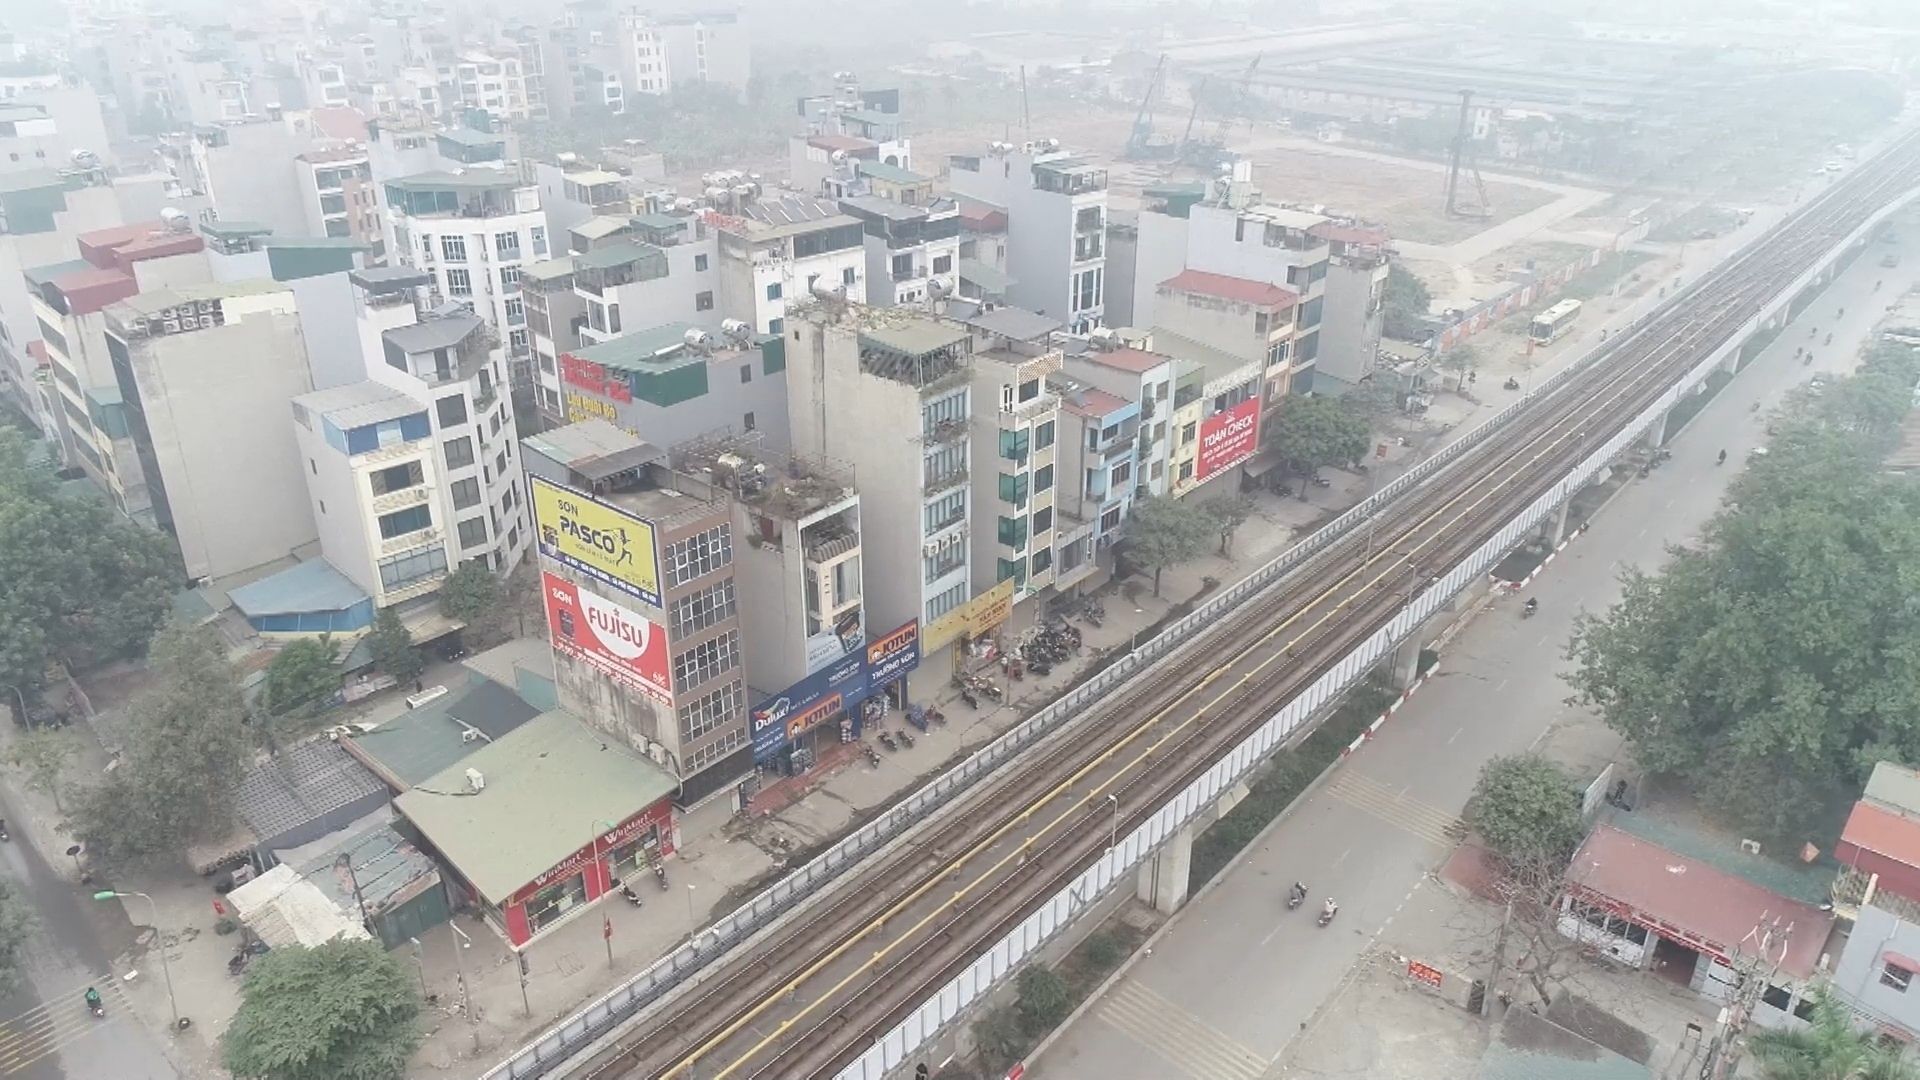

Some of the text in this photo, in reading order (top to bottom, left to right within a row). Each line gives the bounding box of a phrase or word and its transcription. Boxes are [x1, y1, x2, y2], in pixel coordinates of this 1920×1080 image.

[1228, 413, 1254, 436] CHECK
[560, 516, 615, 554] PASCO
[588, 606, 643, 648] FUJISU
[883, 628, 915, 653] JOTUN
[755, 709, 786, 731] Dulux
[805, 697, 840, 728] JOTUN
